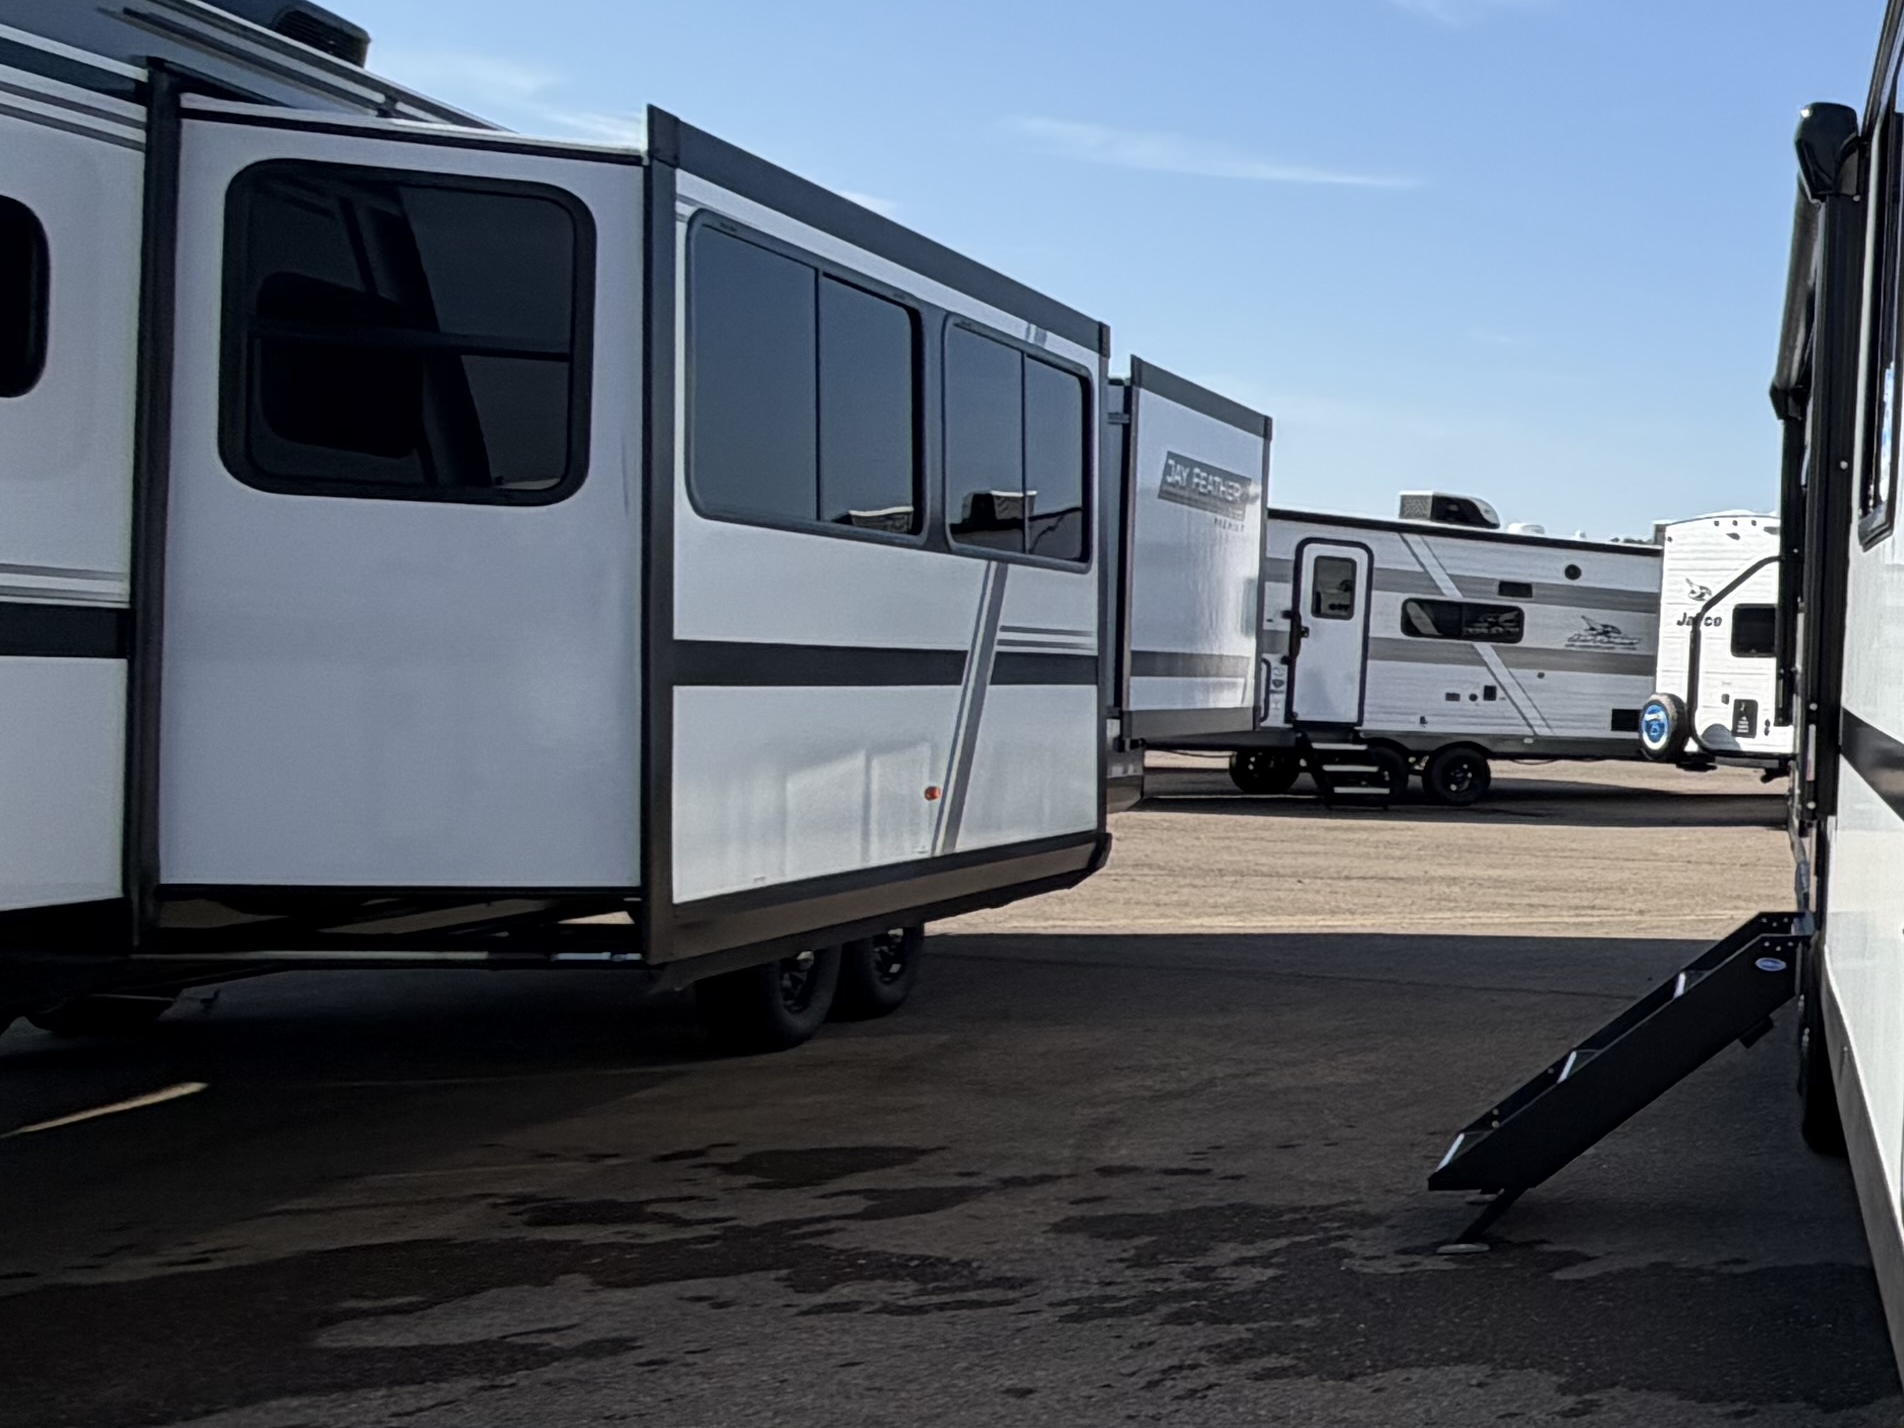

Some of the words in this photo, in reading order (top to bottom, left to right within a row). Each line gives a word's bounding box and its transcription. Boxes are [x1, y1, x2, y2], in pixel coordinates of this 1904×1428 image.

[1165, 458, 1190, 487] JAY
[1192, 467, 1241, 501] FEATHER
[1676, 612, 1723, 627] Jaco
